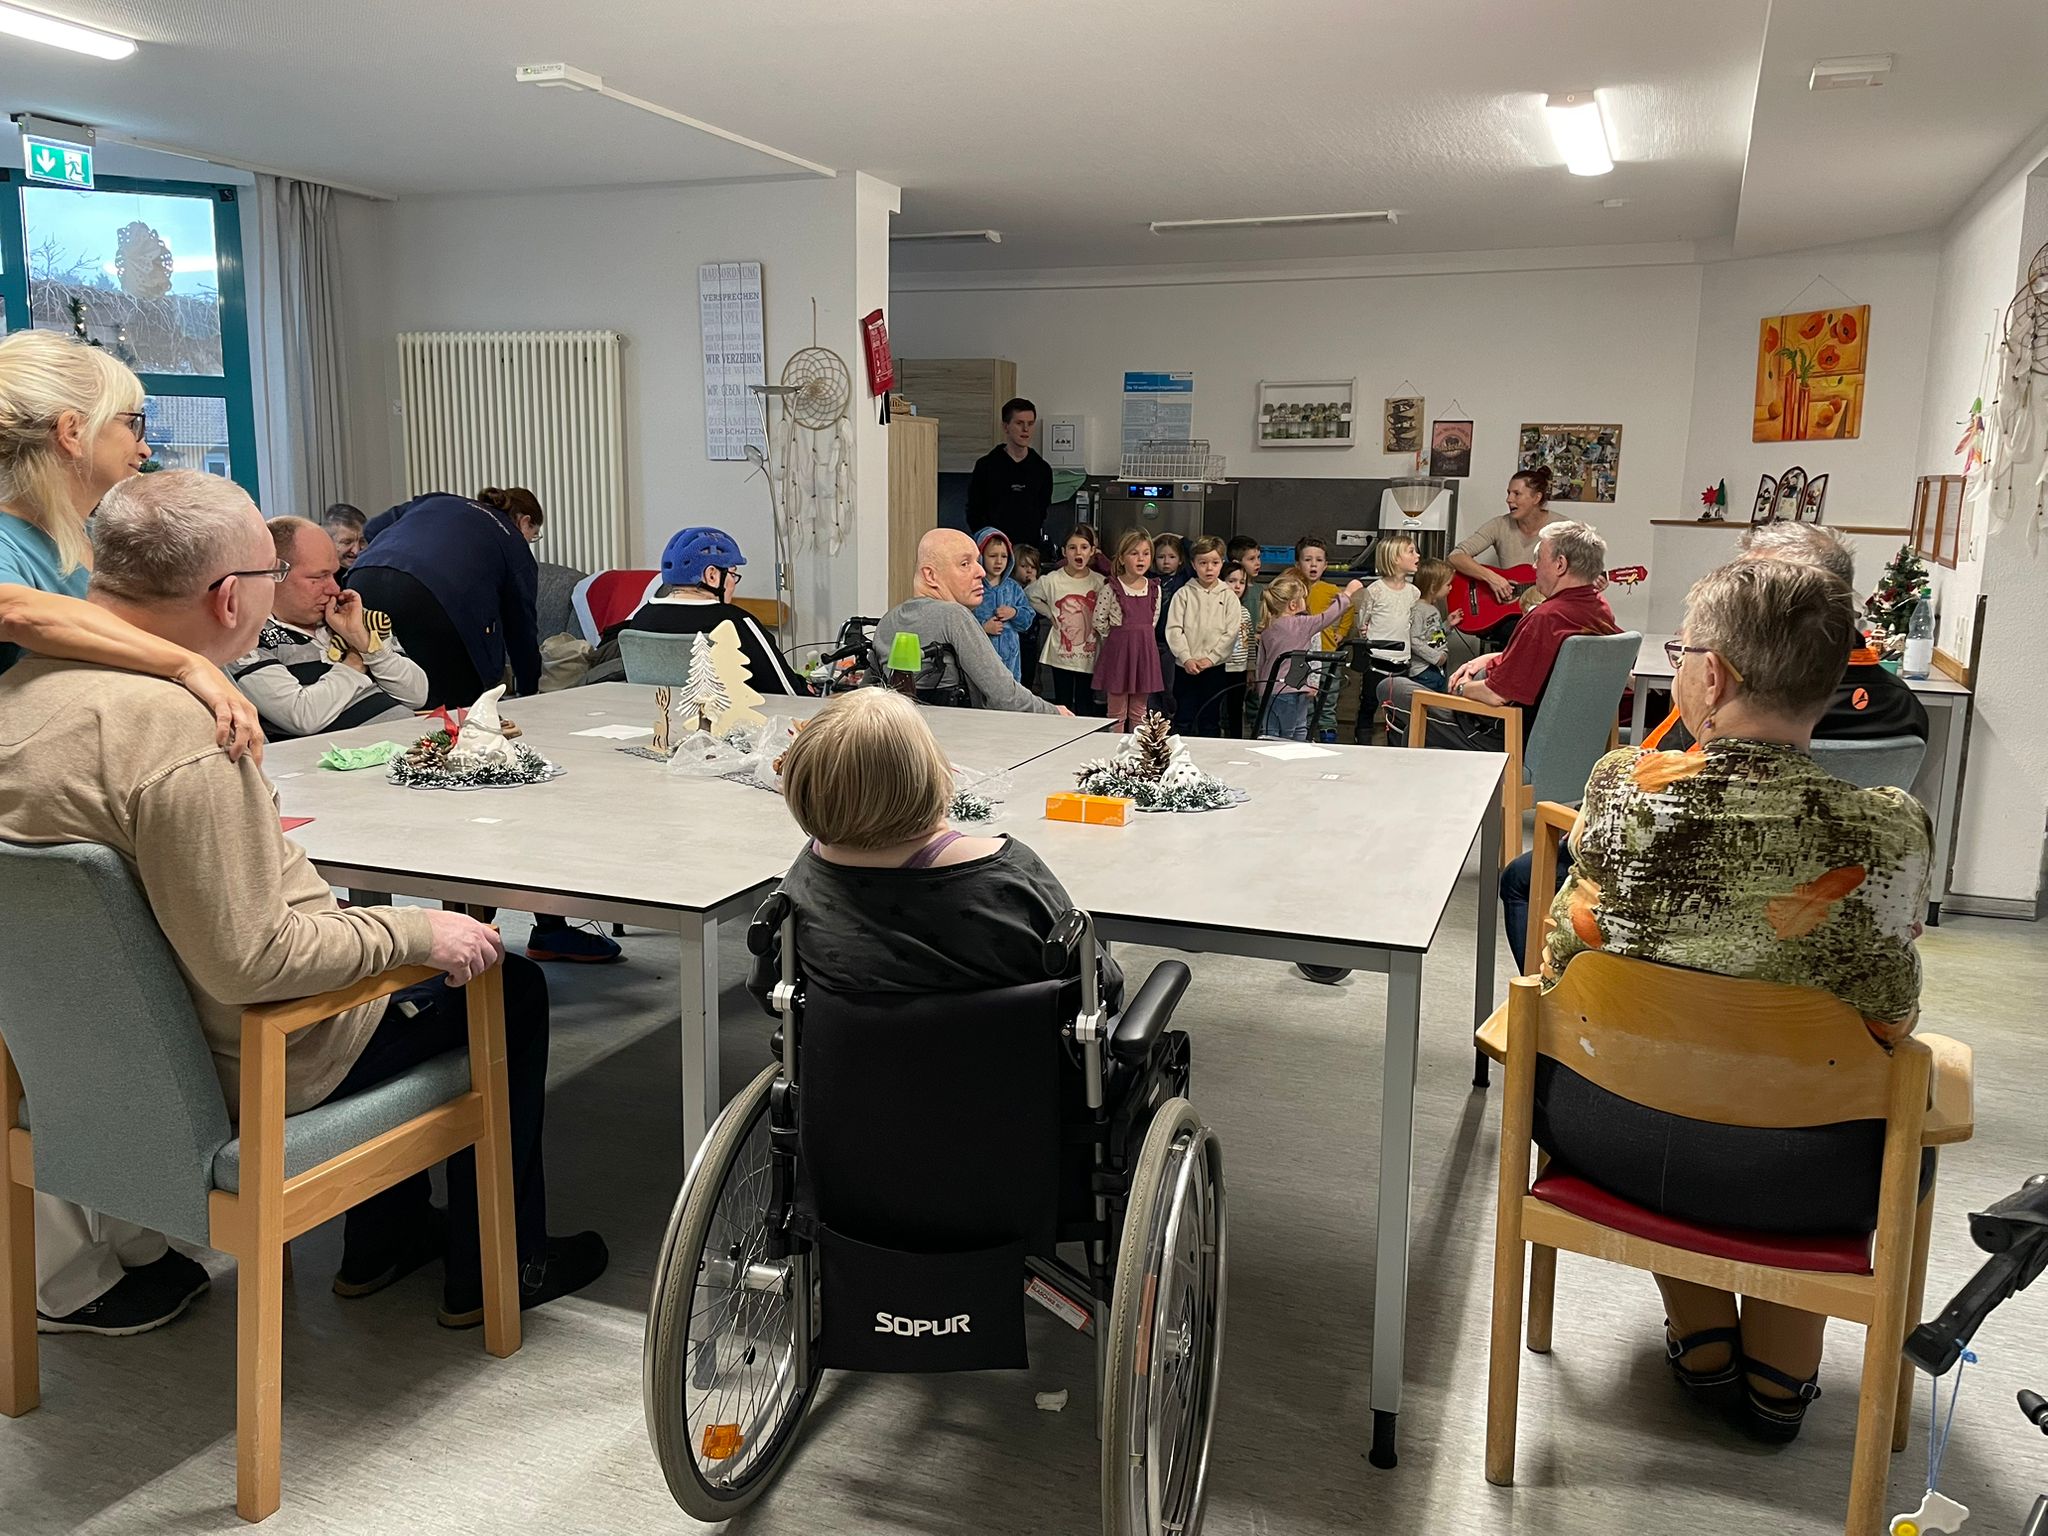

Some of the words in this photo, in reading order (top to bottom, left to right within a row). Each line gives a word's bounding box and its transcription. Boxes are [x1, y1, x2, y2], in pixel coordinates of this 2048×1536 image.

[702, 292, 760, 302] VERSPRECHEN
[705, 353, 720, 364] WIR
[722, 352, 762, 364] VERZEIHEN
[708, 427, 724, 435] WIR
[875, 1312, 971, 1337] SOPUR
